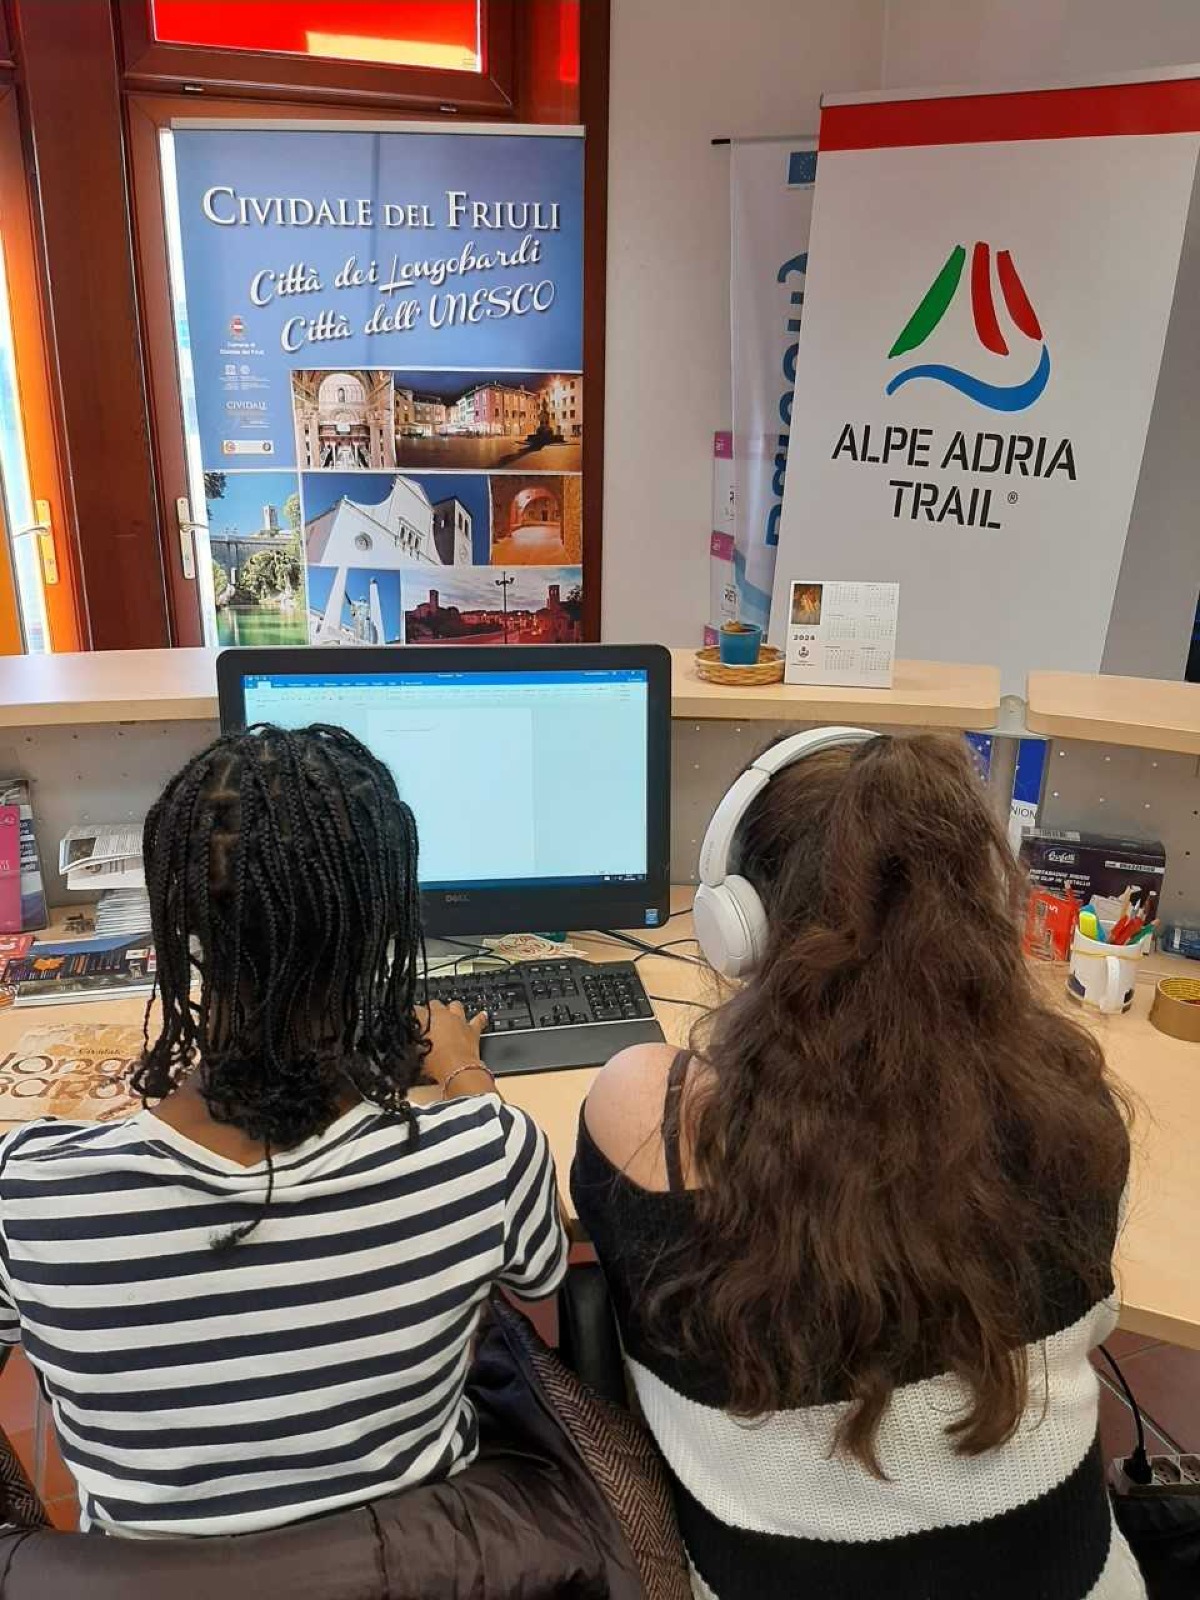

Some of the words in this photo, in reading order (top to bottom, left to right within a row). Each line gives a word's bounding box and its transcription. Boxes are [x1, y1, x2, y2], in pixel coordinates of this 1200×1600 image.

[203, 186, 372, 227] CIVIDALE
[383, 204, 435, 228] DEL
[445, 190, 561, 231] FRIULI
[250, 261, 322, 306] Città
[334, 253, 379, 286] dei
[379, 234, 541, 294] Longobardi
[281, 312, 351, 352] Città
[365, 304, 422, 336] dell'
[429, 279, 555, 329] UNESCO
[831, 423, 933, 467] ALPE
[940, 431, 1077, 481] ADRIA
[889, 480, 1001, 529] TRAIL
